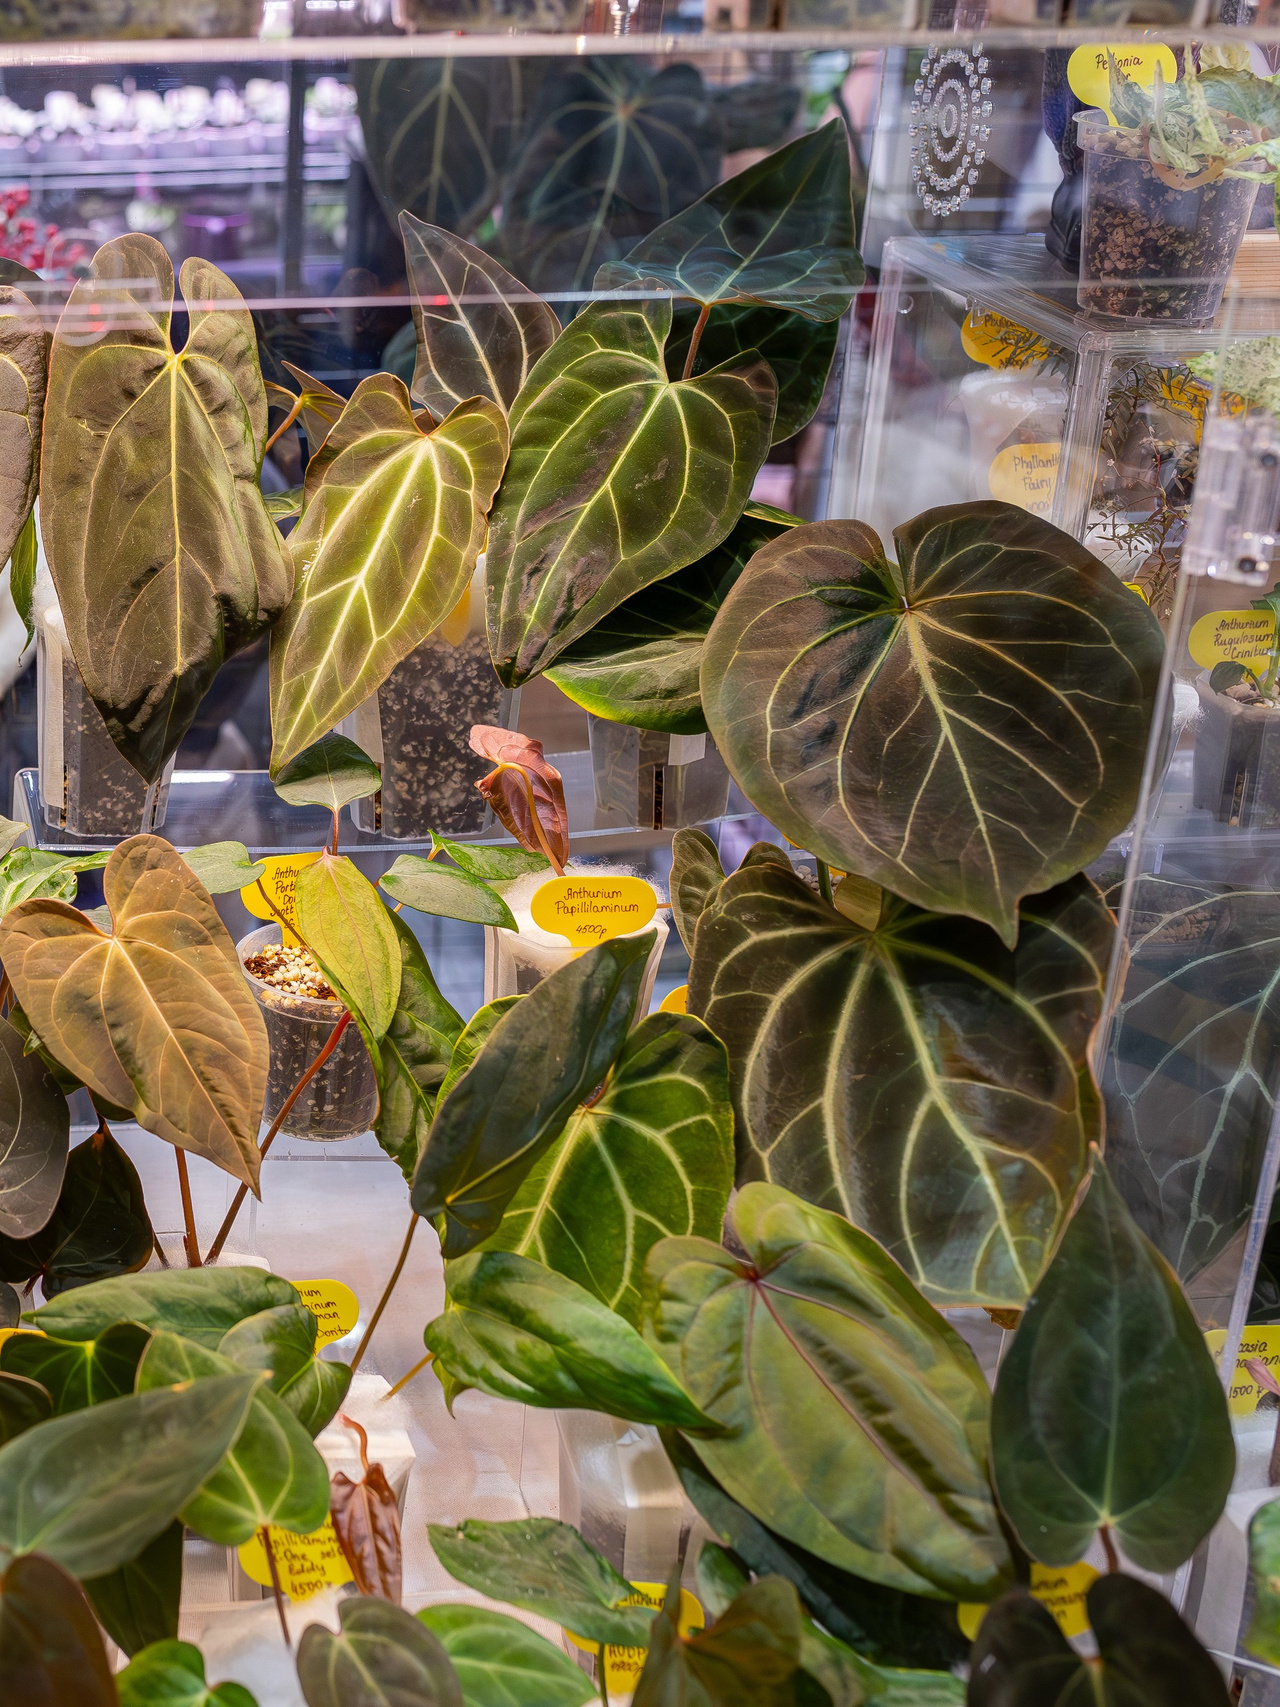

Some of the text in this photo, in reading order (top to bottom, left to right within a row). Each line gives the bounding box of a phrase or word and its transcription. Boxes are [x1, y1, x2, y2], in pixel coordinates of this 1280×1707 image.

[1022, 475, 1052, 501] Fairy
[1215, 618, 1269, 632] Anthurium
[1213, 632, 1273, 656] Rugulosum
[563, 886, 622, 901] Anthurium
[554, 900, 640, 917] Papillilaminum
[1228, 1384, 1254, 1399] 1500
[287, 1561, 326, 1577] Eddy
